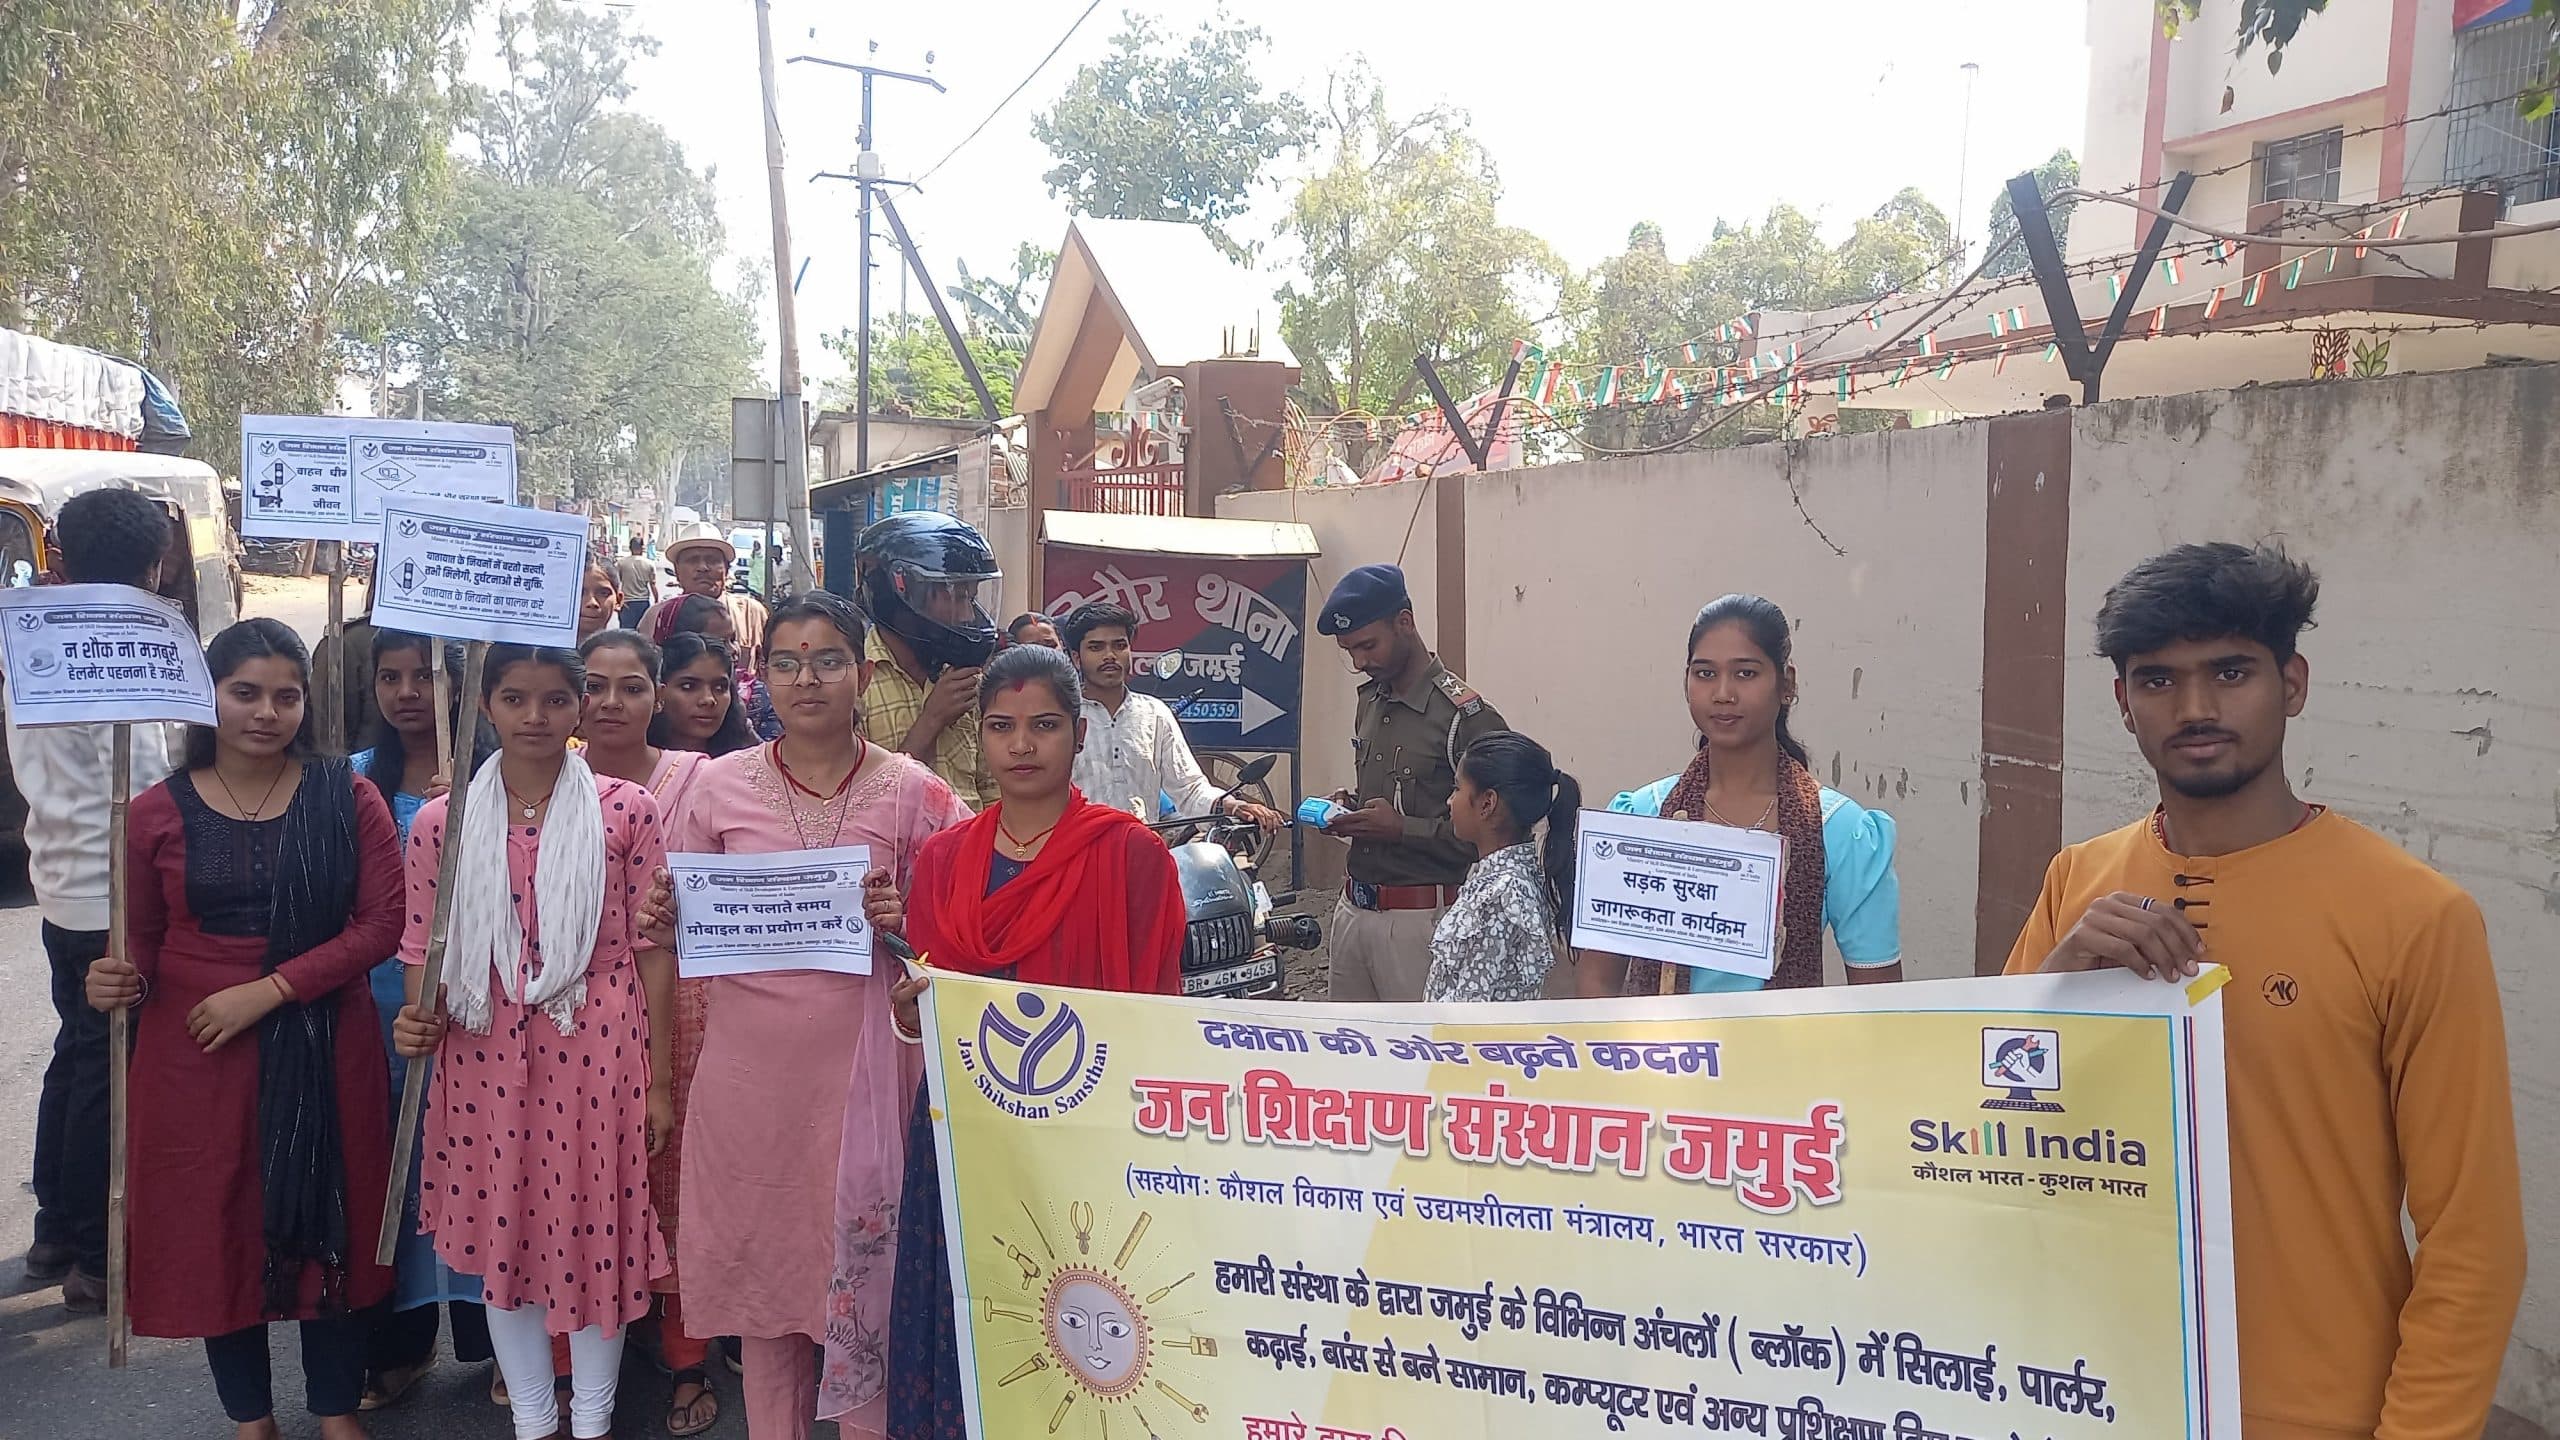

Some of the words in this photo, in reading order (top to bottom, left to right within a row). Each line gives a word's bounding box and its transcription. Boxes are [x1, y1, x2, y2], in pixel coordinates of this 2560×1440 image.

[311, 483, 340, 494] अपना
[313, 498, 341, 511] जीवन
[1195, 573, 1299, 663] थाना
[62, 642, 79, 660] न
[82, 636, 113, 660] शौक
[116, 641, 135, 659] ना
[138, 641, 184, 667] मजबूरी,
[67, 662, 105, 681] हेलमेट
[107, 665, 147, 680] पहनना
[149, 662, 158, 681] है
[1184, 642, 1246, 685] जमुई
[1623, 871, 1667, 894] सड़क
[1673, 878, 1719, 902] सुरक्षा
[687, 921, 739, 937] मोबाइल
[744, 923, 763, 935] का
[766, 920, 804, 935] प्रयोग
[807, 921, 817, 931] न
[820, 915, 843, 931] करें
[713, 902, 749, 916] वाहन
[752, 899, 792, 915] चलाते
[796, 900, 831, 912] समय
[1591, 898, 1675, 927] जागरूकता
[1682, 911, 1747, 938] कार्यक्रम
[1188, 977, 1203, 990] BR
[1200, 1019, 1308, 1053] दक्षता
[1319, 1026, 1378, 1057] की
[1389, 1035, 1469, 1066] ओर
[1478, 1034, 1578, 1079] बढ़ते
[1591, 1040, 1720, 1078] कदम
[957, 1036, 975, 1076] Jan
[973, 1071, 1050, 1121] Shikshan
[1055, 1041, 1109, 1116] Sansthan
[1133, 1075, 1231, 1140] जन
[1242, 1067, 1433, 1153] शिक्षण
[1444, 1083, 1652, 1175] संस्थान
[1663, 1102, 1846, 1213] जमुई
[1909, 1117, 2007, 1158] Skill
[2025, 1125, 2147, 1167] India
[1911, 1161, 1972, 1185] कौशल
[1978, 1167, 2025, 1189] भारत
[2039, 1171, 2093, 1197] कुशल
[2099, 1175, 2148, 1199] भारत
[1217, 1166, 1284, 1206] कौशल
[1294, 1174, 1363, 1213] विकास
[1374, 1180, 1403, 1217] एवं
[1414, 1190, 1555, 1233] उद्यमशीलता
[1562, 1204, 1665, 1248] मंत्रालय,
[1677, 1217, 1744, 1255] भारत
[1757, 1230, 1869, 1278] सरकार)
[1214, 1252, 1276, 1297] हमारी
[1280, 1262, 1340, 1305] संस्था
[1344, 1267, 1371, 1310] के
[1376, 1278, 1423, 1318] द्वारा
[1429, 1282, 1494, 1342] जमुई
[1500, 1285, 1526, 1333] के
[1533, 1290, 1627, 1346] विभिन्न
[1633, 1306, 1722, 1361] अंचलों
[1856, 1331, 1887, 1379] में
[1894, 1335, 2009, 1403] सिलाई,
[2017, 1358, 2118, 1424] पार्लर,
[1246, 1325, 1318, 1377] कढ़ाई,
[1322, 1332, 1371, 1377] बांस
[1374, 1335, 1397, 1380] से
[1402, 1344, 1440, 1385] बने
[1446, 1360, 1536, 1405] सामान,
[1542, 1370, 1650, 1432] कम्प्यूटर
[1654, 1383, 1699, 1427] एवं
[1702, 1397, 1770, 1438] अन्य
